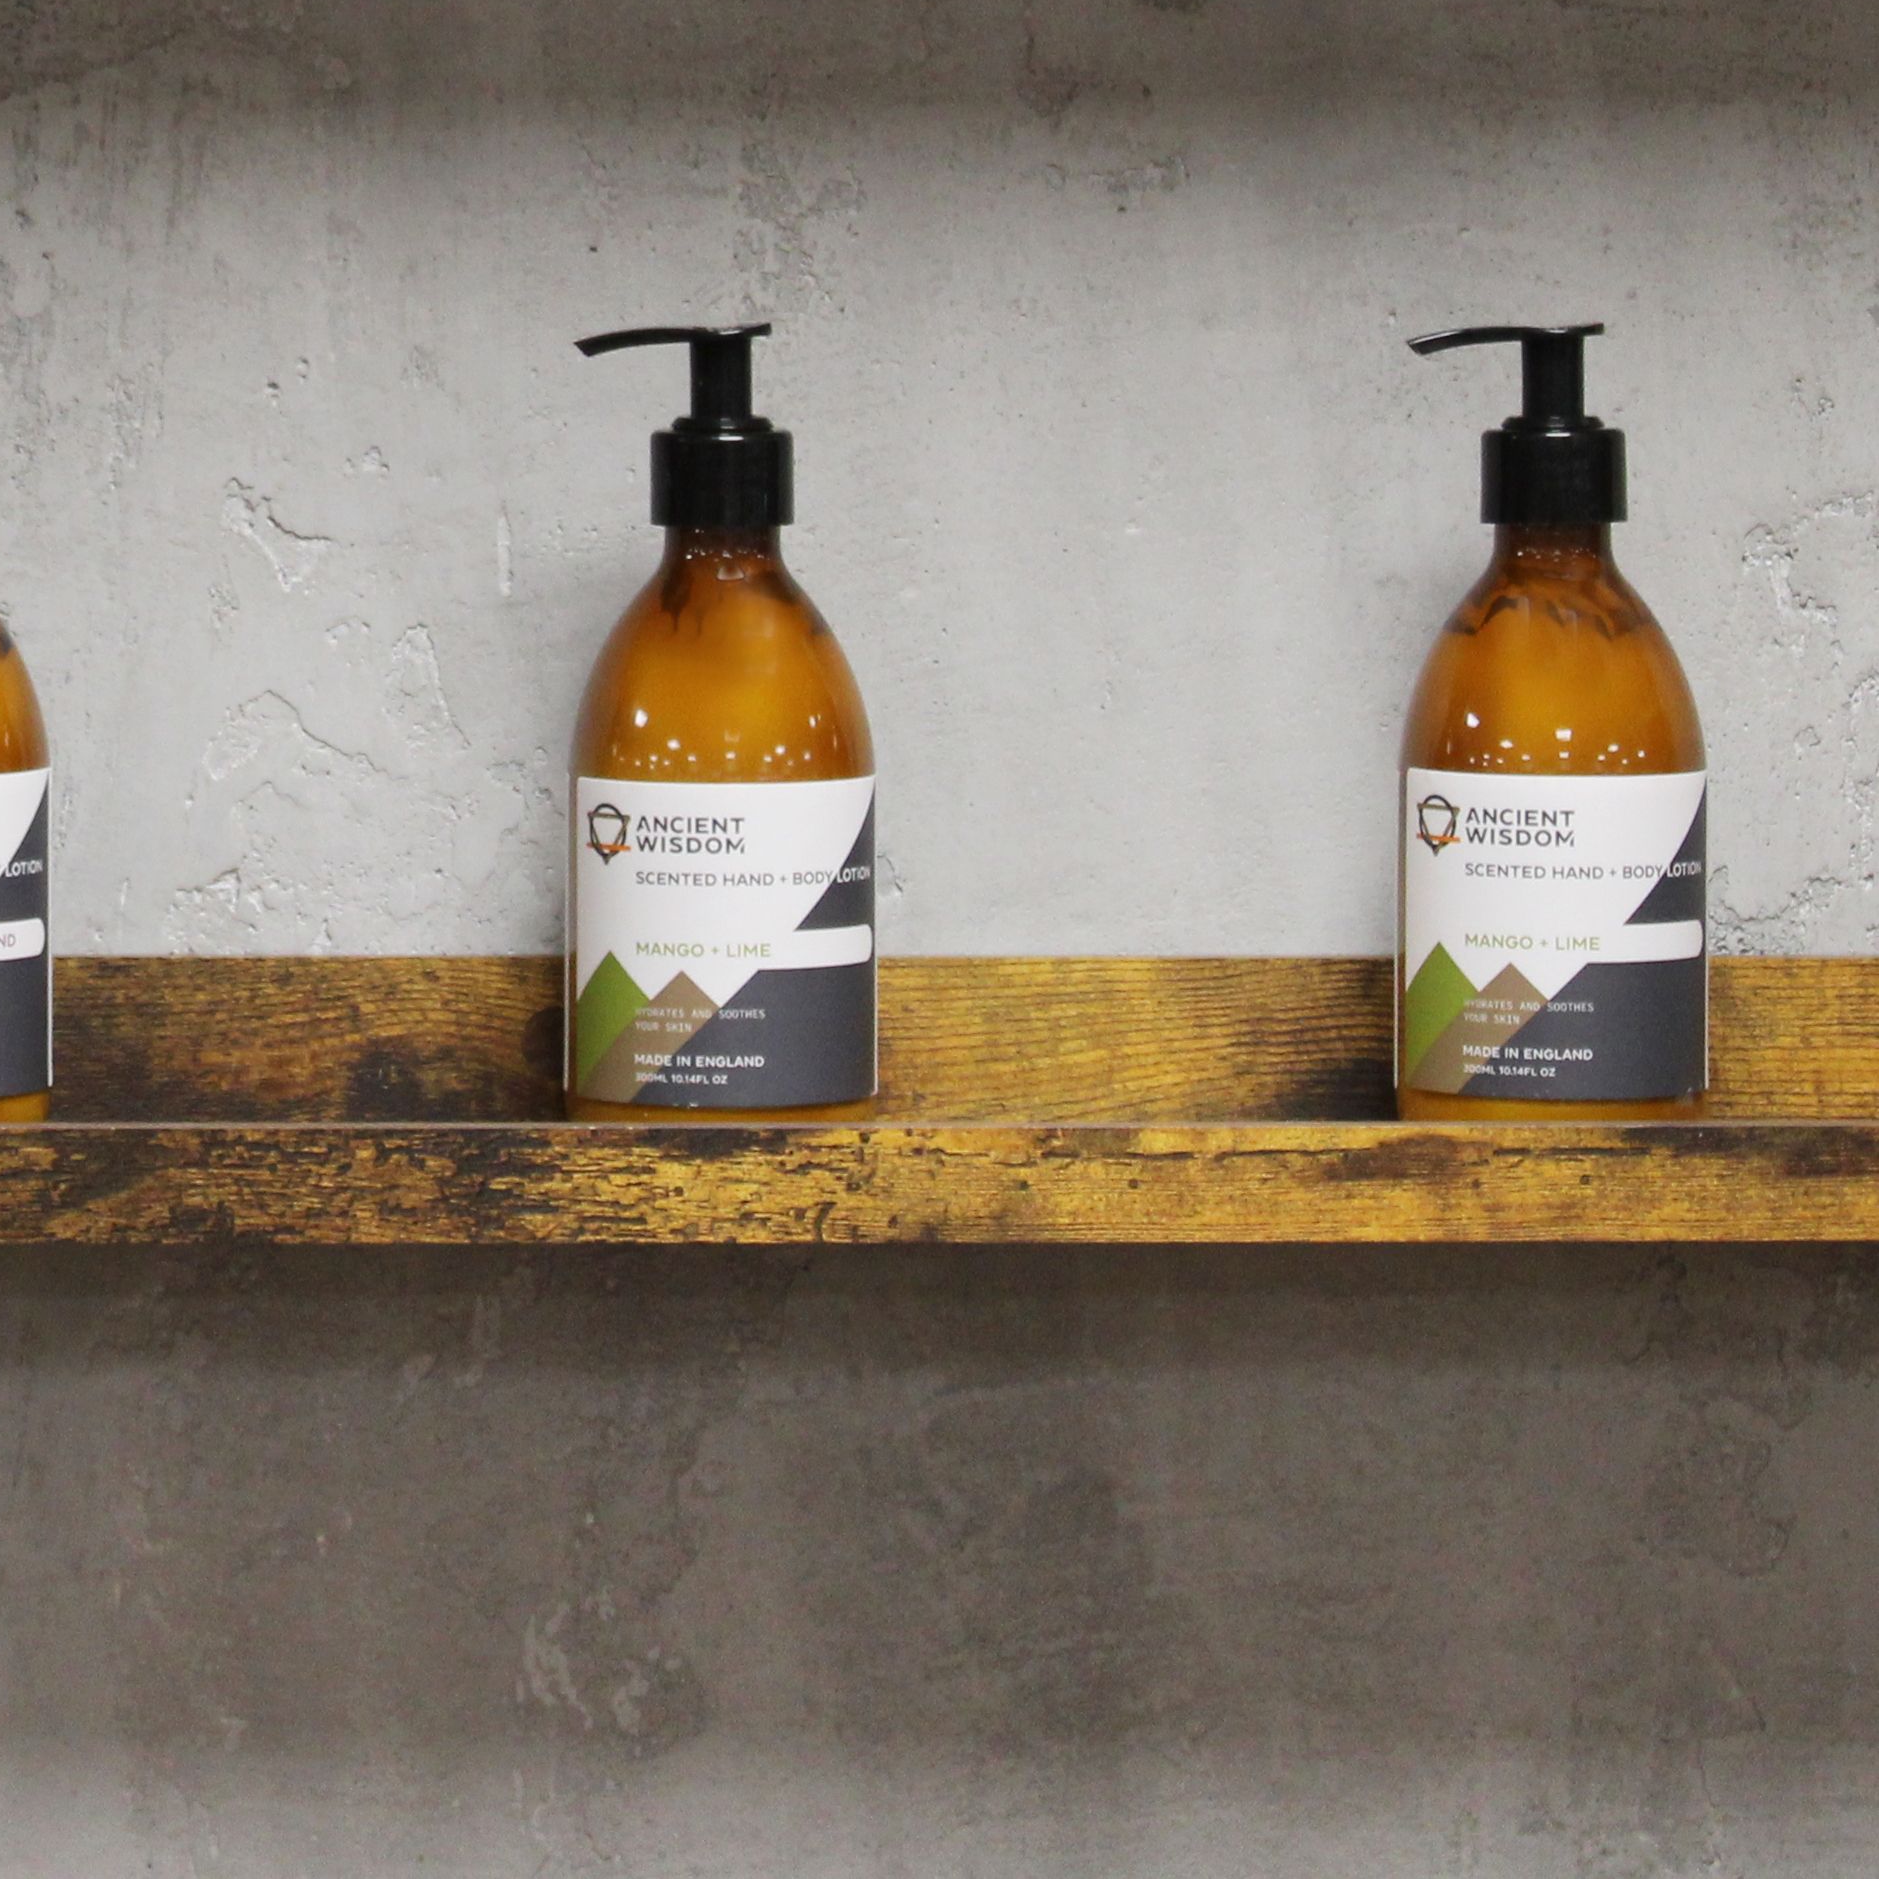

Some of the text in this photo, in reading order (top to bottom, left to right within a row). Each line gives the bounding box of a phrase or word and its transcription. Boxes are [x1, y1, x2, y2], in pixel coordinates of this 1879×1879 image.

[637, 817, 744, 834] ANCIENT
[1466, 808, 1574, 827] ANCIENT
[637, 837, 745, 854] WISDOM
[1466, 828, 1574, 847] WISDOM
[4, 860, 43, 877] LOTION
[636, 872, 717, 886] SCENTED
[723, 873, 774, 886] HAND
[793, 871, 833, 885] BODY
[836, 867, 870, 884] LOTION
[1465, 864, 1546, 879] SCENTED
[1553, 866, 1604, 879] HAND
[1623, 866, 1663, 879] BODY
[1667, 862, 1702, 877] LOTION
[636, 942, 704, 957] MANGO
[727, 944, 771, 958] LIME
[1465, 934, 1533, 950] MANGO
[1556, 937, 1600, 951] LIME
[634, 1054, 764, 1067] MADE IN ENGLAND
[1463, 1045, 1592, 1060] MADE IN ENGLAND
[712, 1075, 728, 1084] OZ
